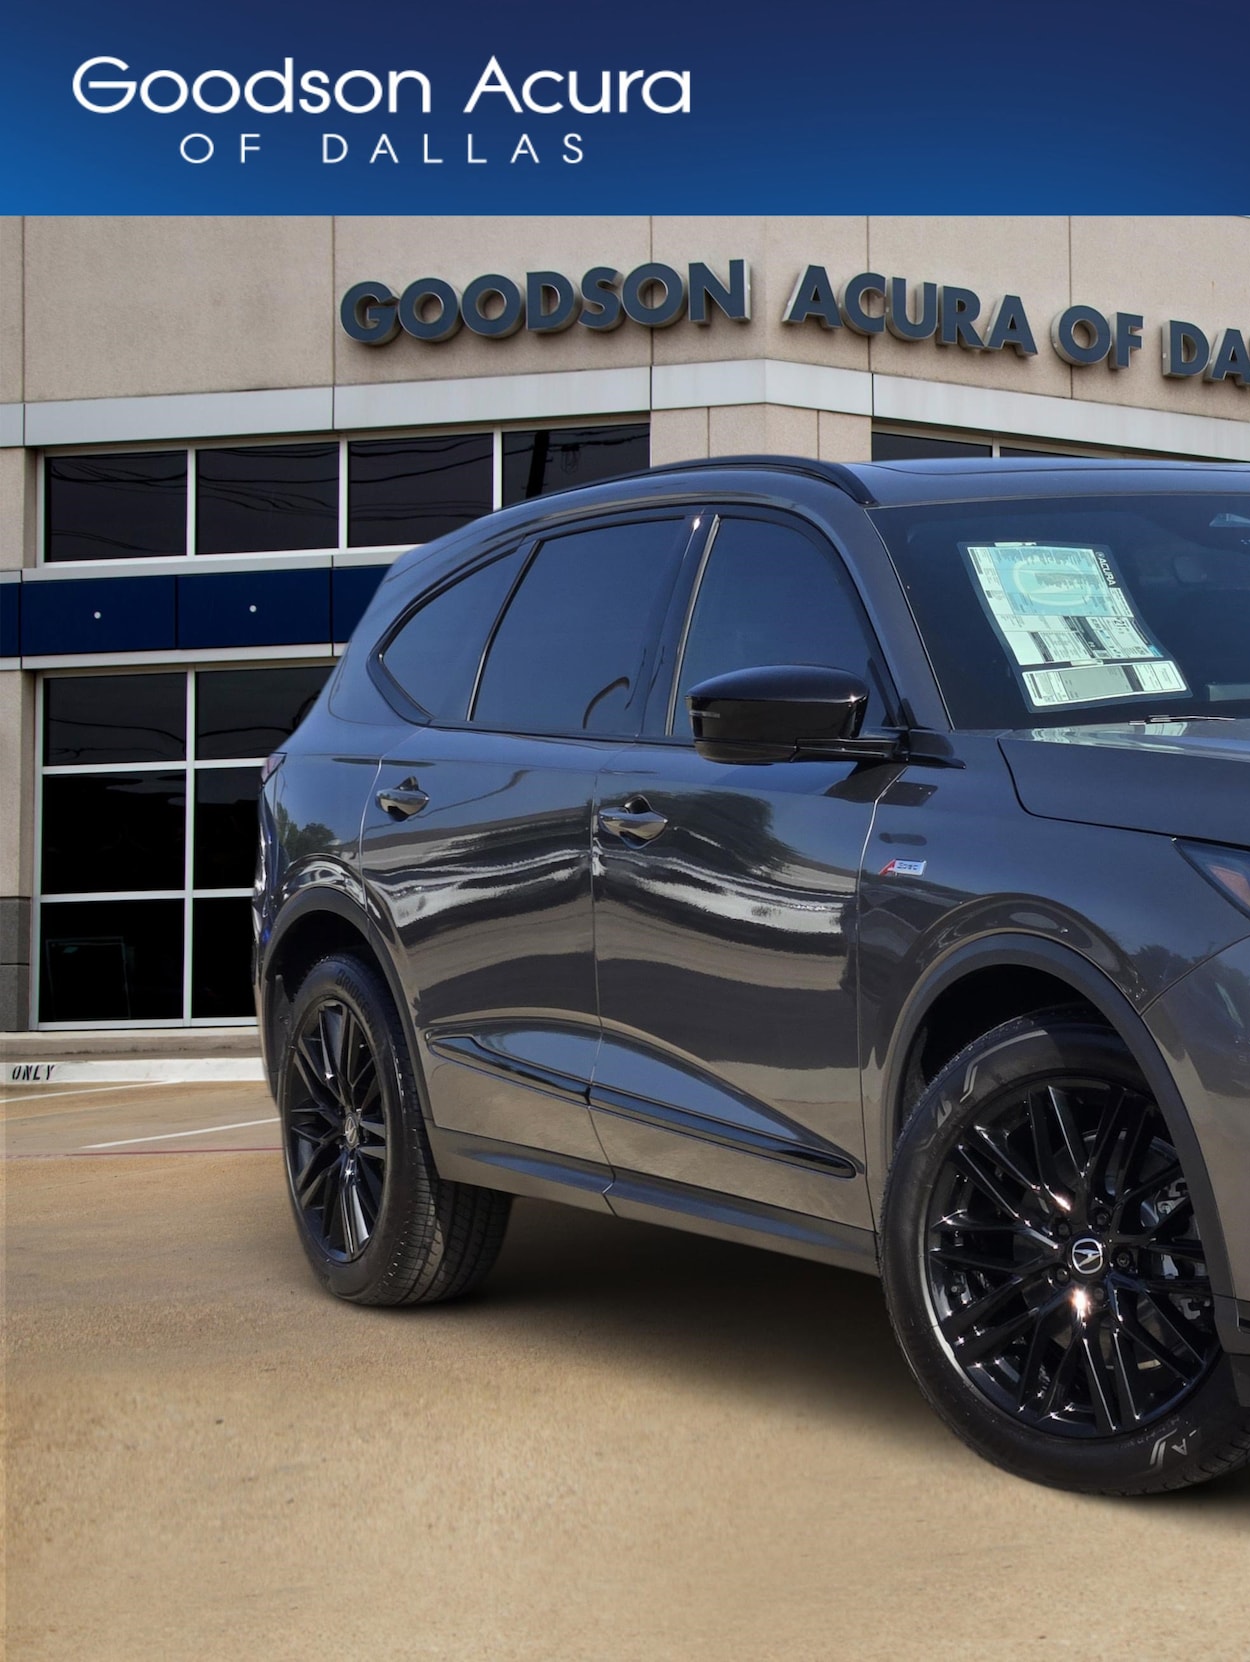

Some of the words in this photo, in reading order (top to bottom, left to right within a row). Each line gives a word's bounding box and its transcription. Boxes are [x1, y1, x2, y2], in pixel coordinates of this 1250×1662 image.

[340, 258, 751, 347] GOODSON
[782, 264, 1039, 357] ACURA
[1050, 304, 1144, 370] OF
[1097, 557, 1117, 586] ACURA
[11, 1064, 56, 1082] ONLY
